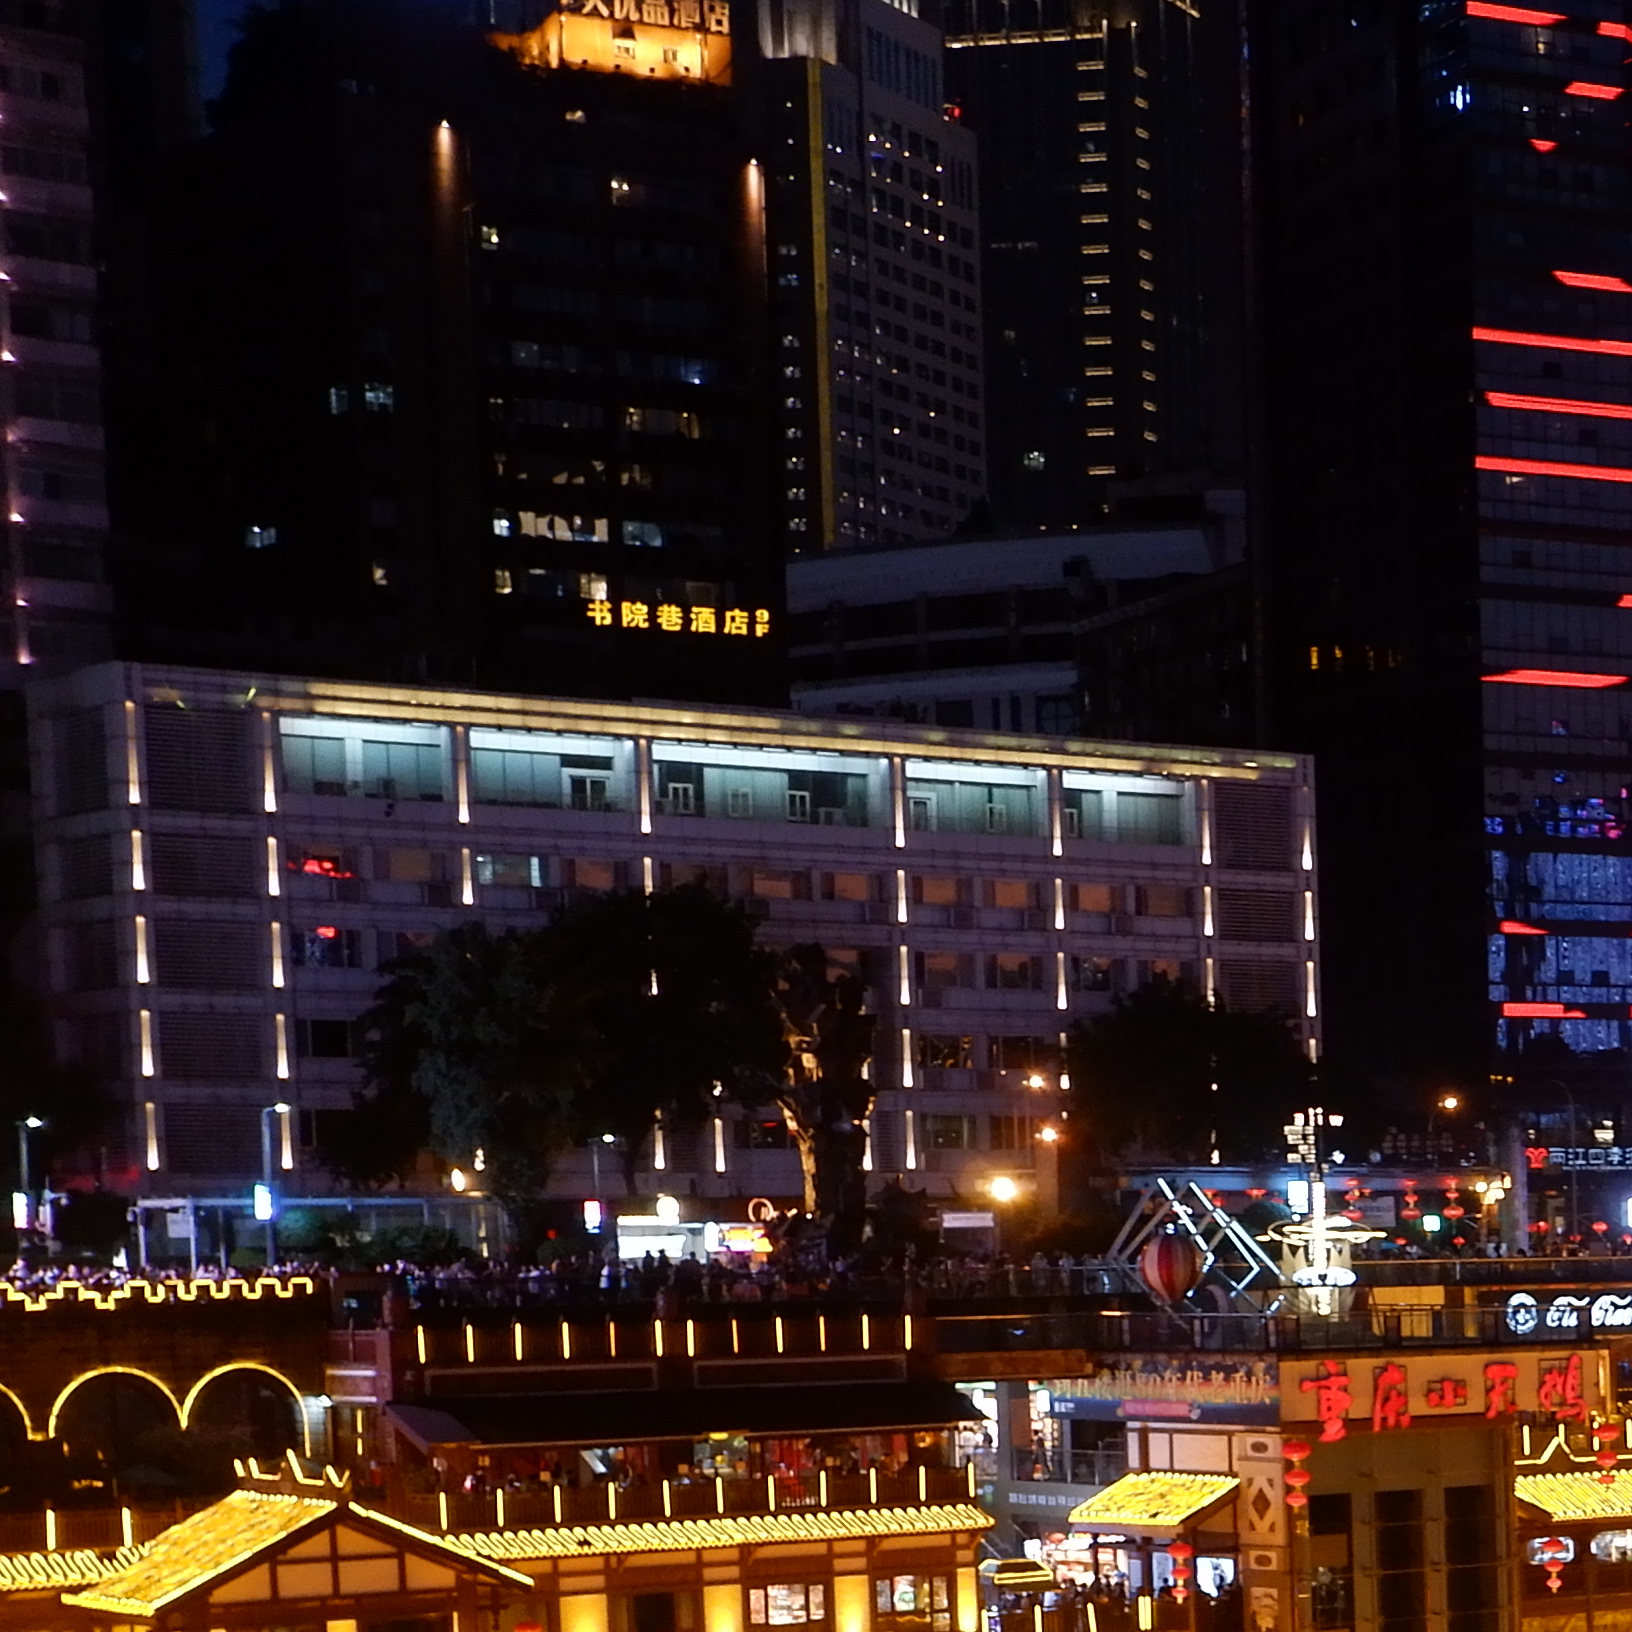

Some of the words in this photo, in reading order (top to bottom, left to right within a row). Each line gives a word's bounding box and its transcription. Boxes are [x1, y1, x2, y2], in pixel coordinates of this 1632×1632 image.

[586, 600, 750, 636] 书院巷酒店
[1300, 1354, 1587, 1443] 重庆小天鹅
